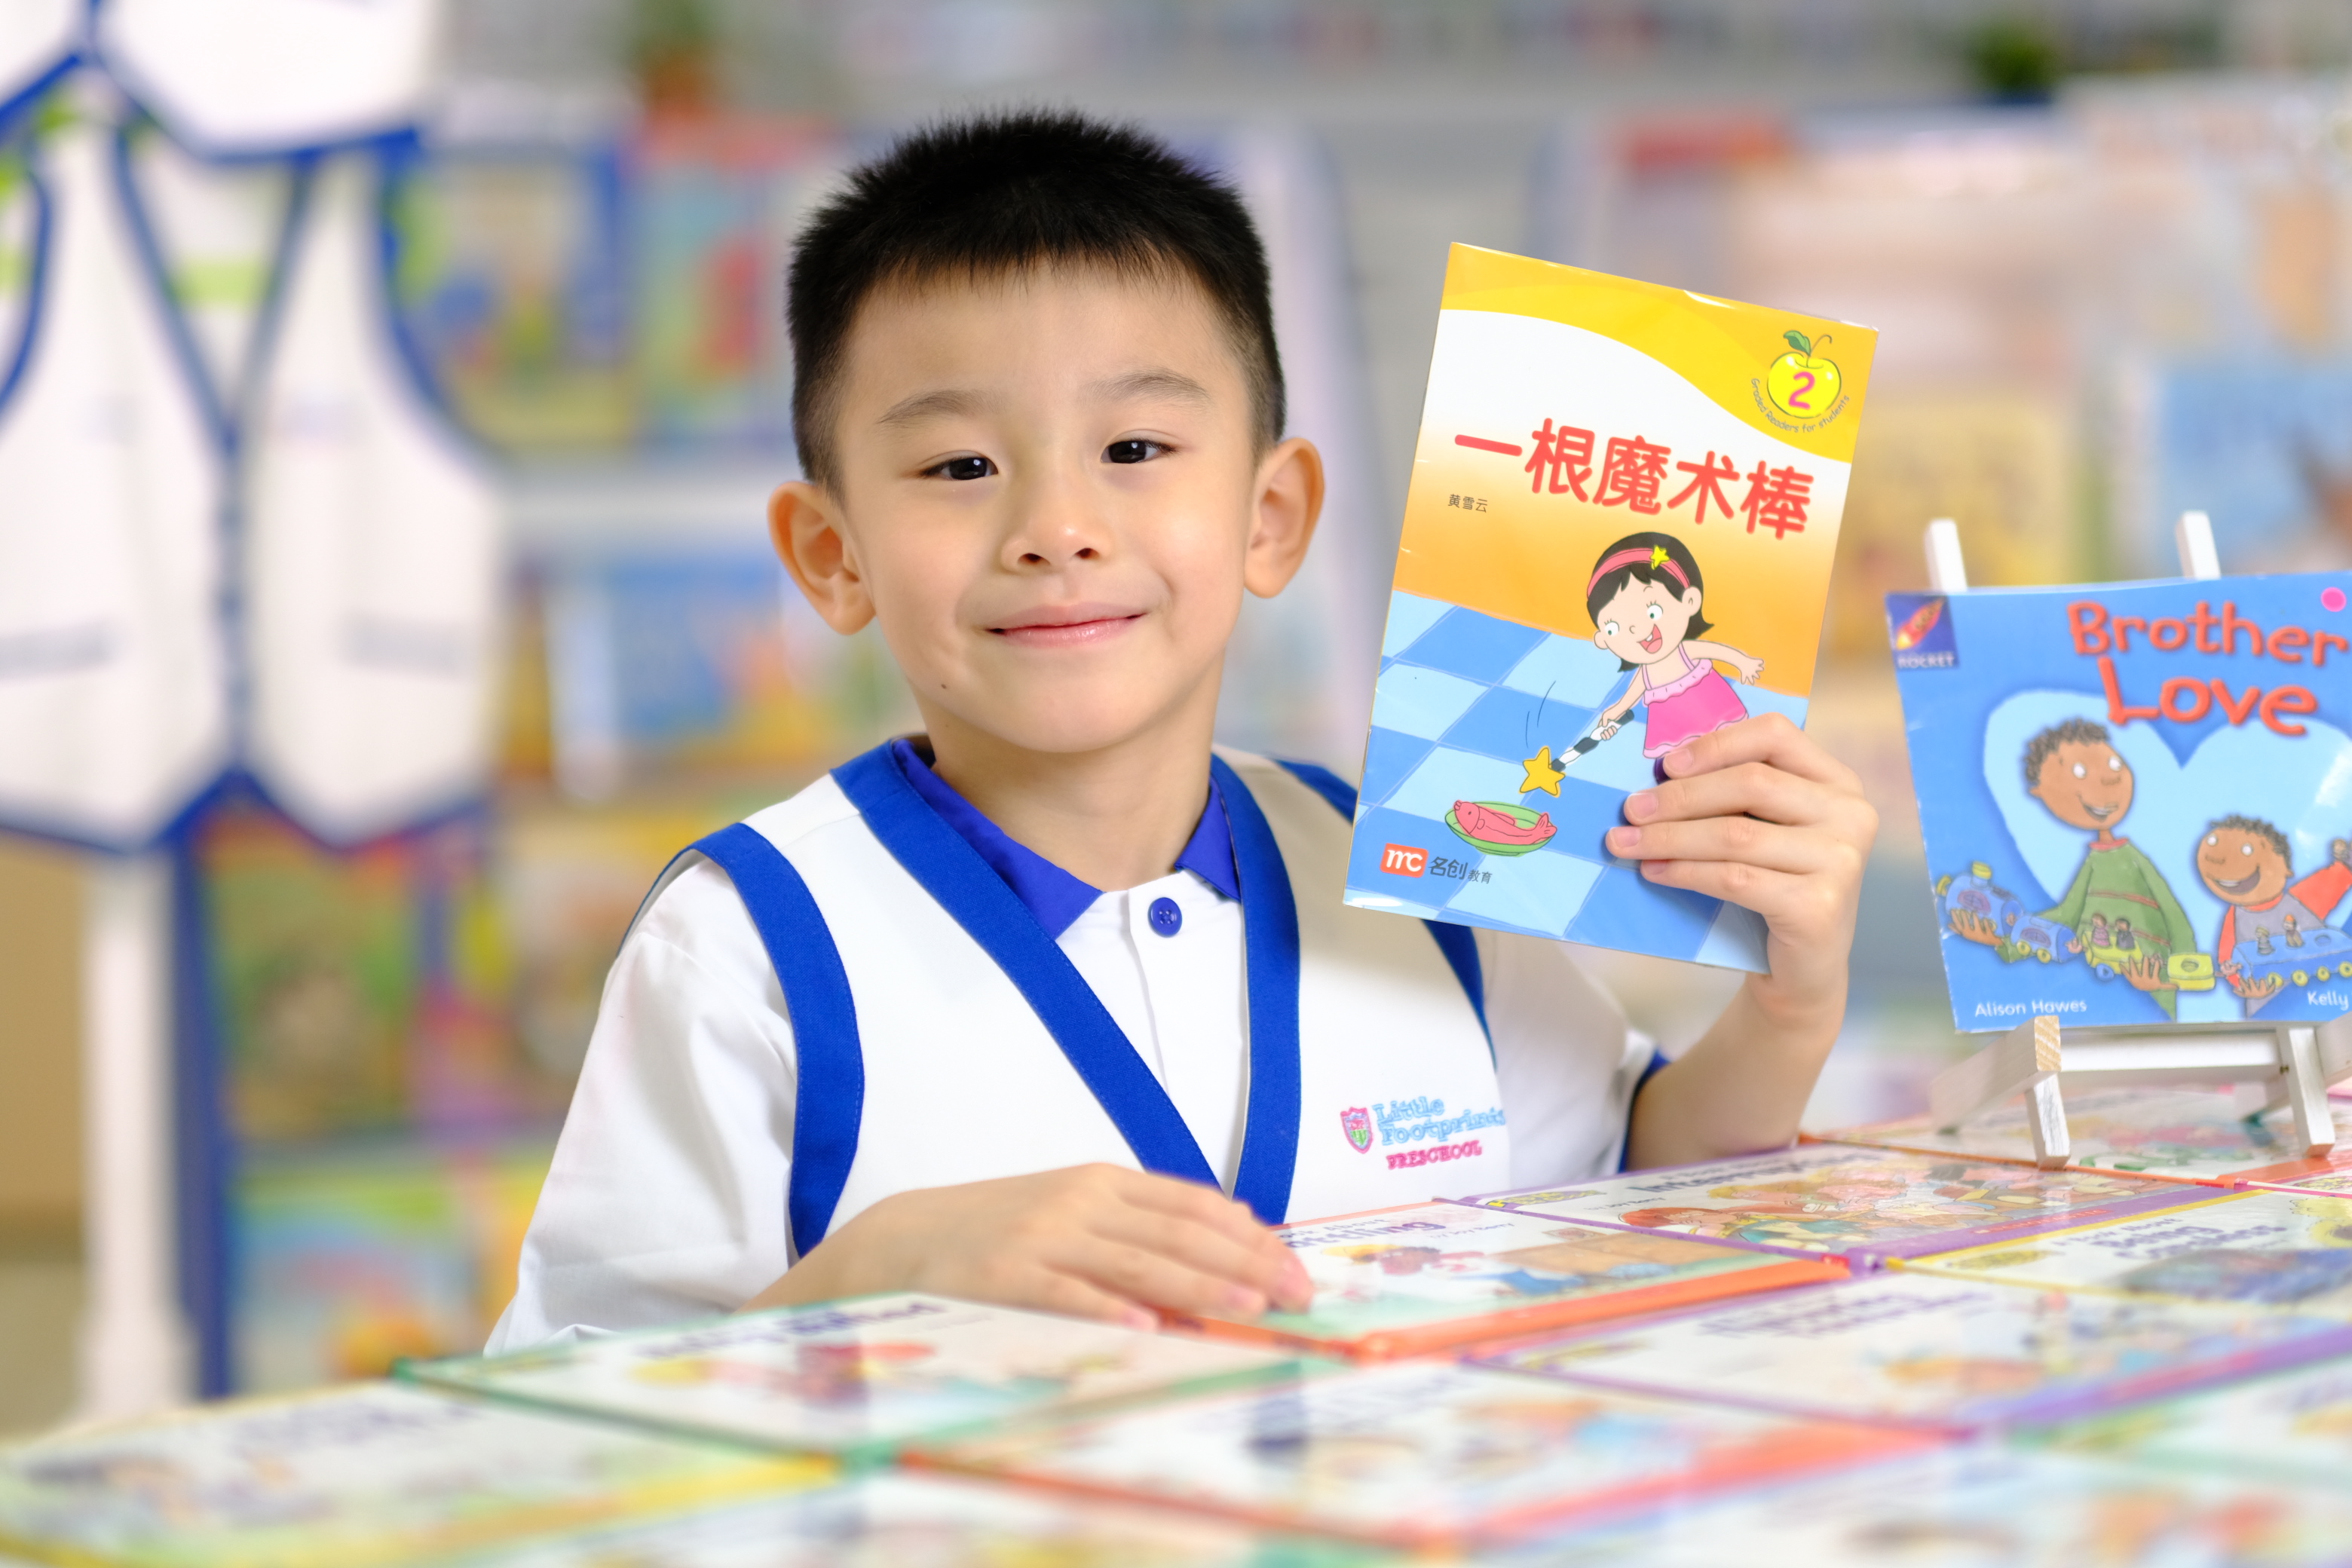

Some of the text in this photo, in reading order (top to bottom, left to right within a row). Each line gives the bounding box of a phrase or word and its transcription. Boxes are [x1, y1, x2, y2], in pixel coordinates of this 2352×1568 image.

[1751, 378, 1850, 433] Graded Readers for students
[1788, 371, 1815, 410] 2
[1455, 418, 1815, 541] 一根魔术棒
[1447, 493, 1488, 513] 黄雪云
[2066, 600, 2350, 666] Brother
[2097, 656, 2319, 736] Love
[1974, 998, 2087, 1017] Alison Hawes
[2307, 990, 2349, 1011] Kelly
[1372, 1096, 1445, 1122] Little
[1377, 1107, 1506, 1146] Footprints
[1386, 1140, 1483, 1170] PRESCHOOL
[1285, 1221, 1447, 1248] attling
